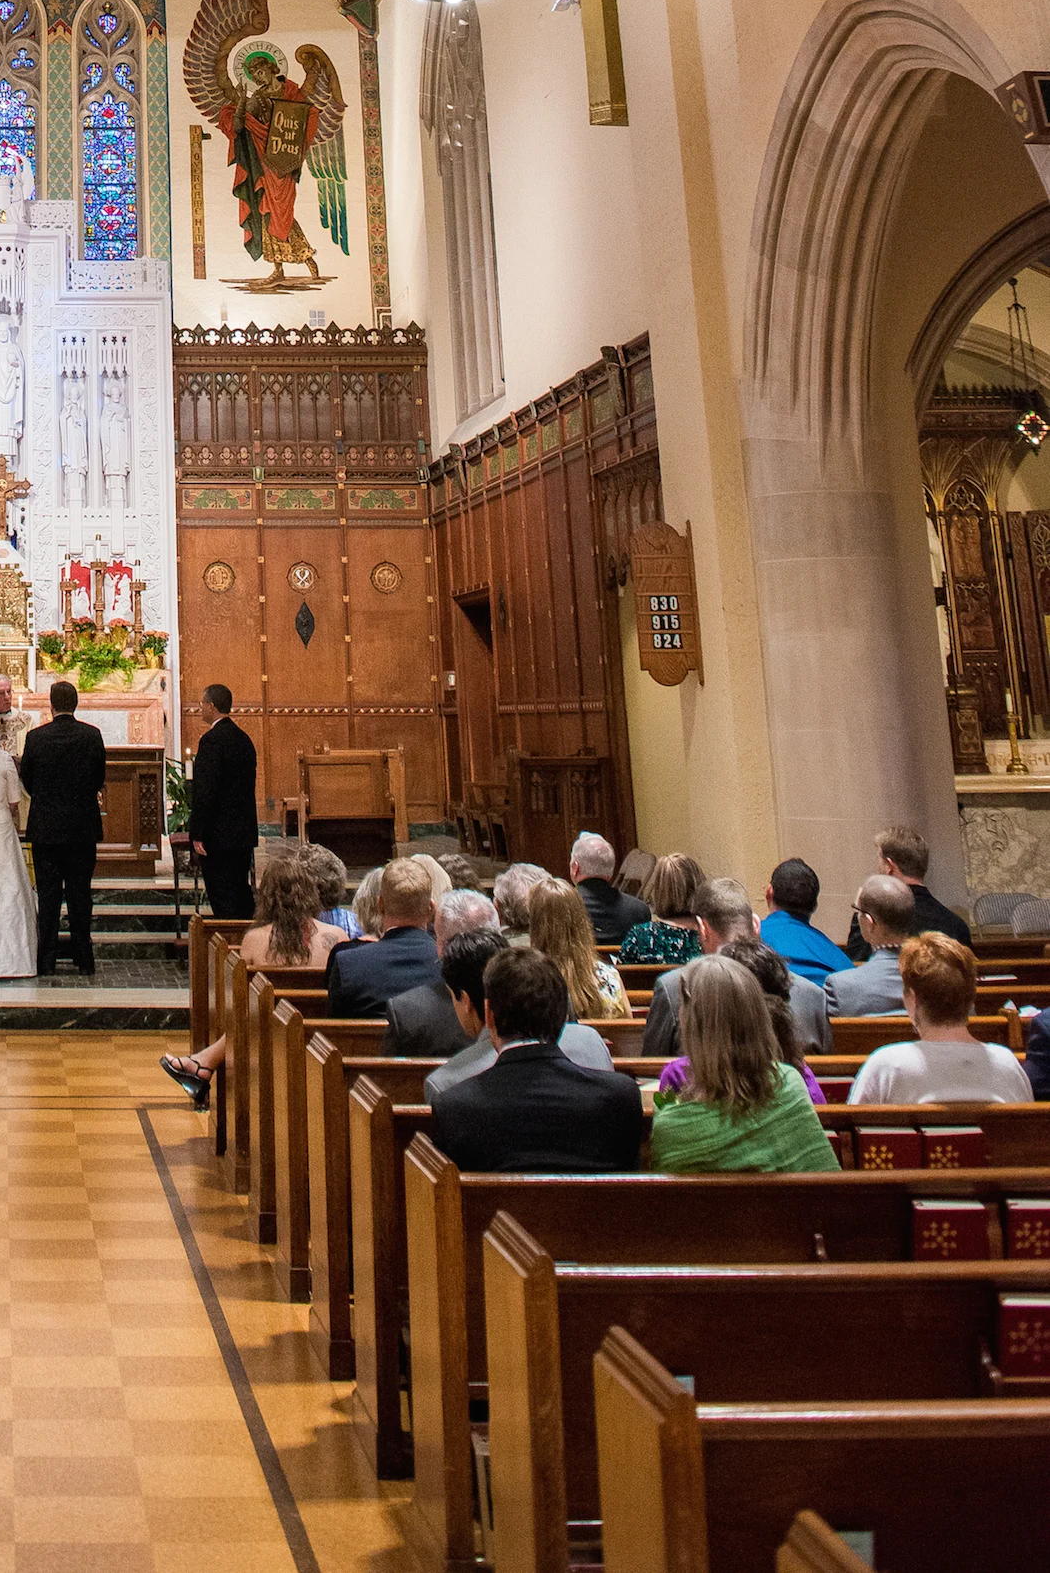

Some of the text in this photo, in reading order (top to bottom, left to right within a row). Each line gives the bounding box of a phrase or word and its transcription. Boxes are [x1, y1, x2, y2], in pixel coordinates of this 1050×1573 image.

[237, 42, 285, 67] MICHAEL
[274, 110, 299, 133] Quis
[271, 136, 299, 155] Deus
[650, 596, 678, 611] 830
[652, 615, 679, 630] 915
[654, 633, 682, 648] 824
